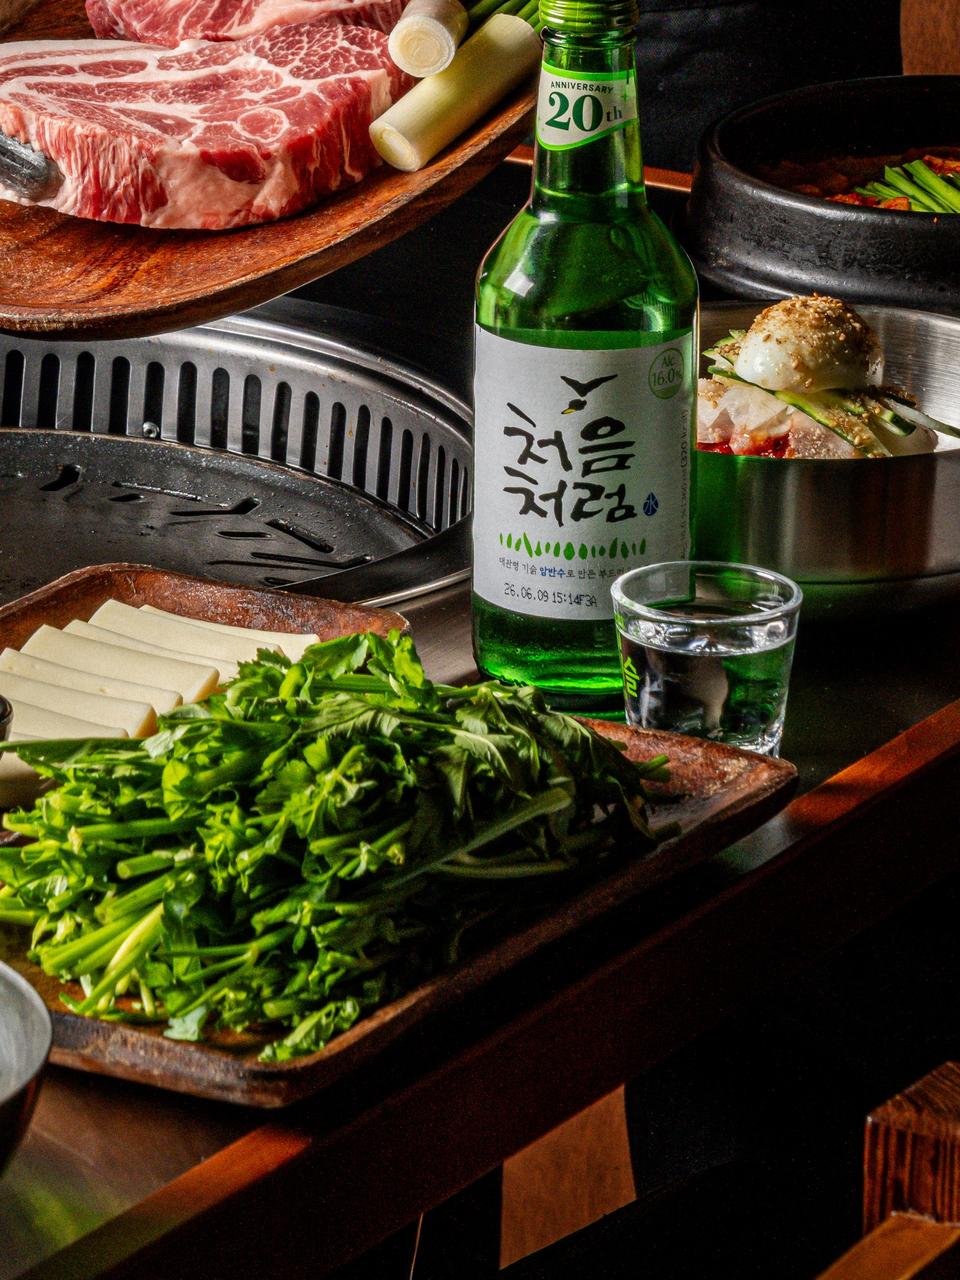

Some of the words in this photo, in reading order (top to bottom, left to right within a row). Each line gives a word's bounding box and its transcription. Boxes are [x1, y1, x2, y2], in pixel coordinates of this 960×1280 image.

[550, 81, 615, 95] ANNIVERSARY
[503, 402, 636, 478] 처음
[503, 466, 638, 528] 처럼
[540, 565, 575, 579] 암반수로
[504, 582, 549, 603] 26.06.09
